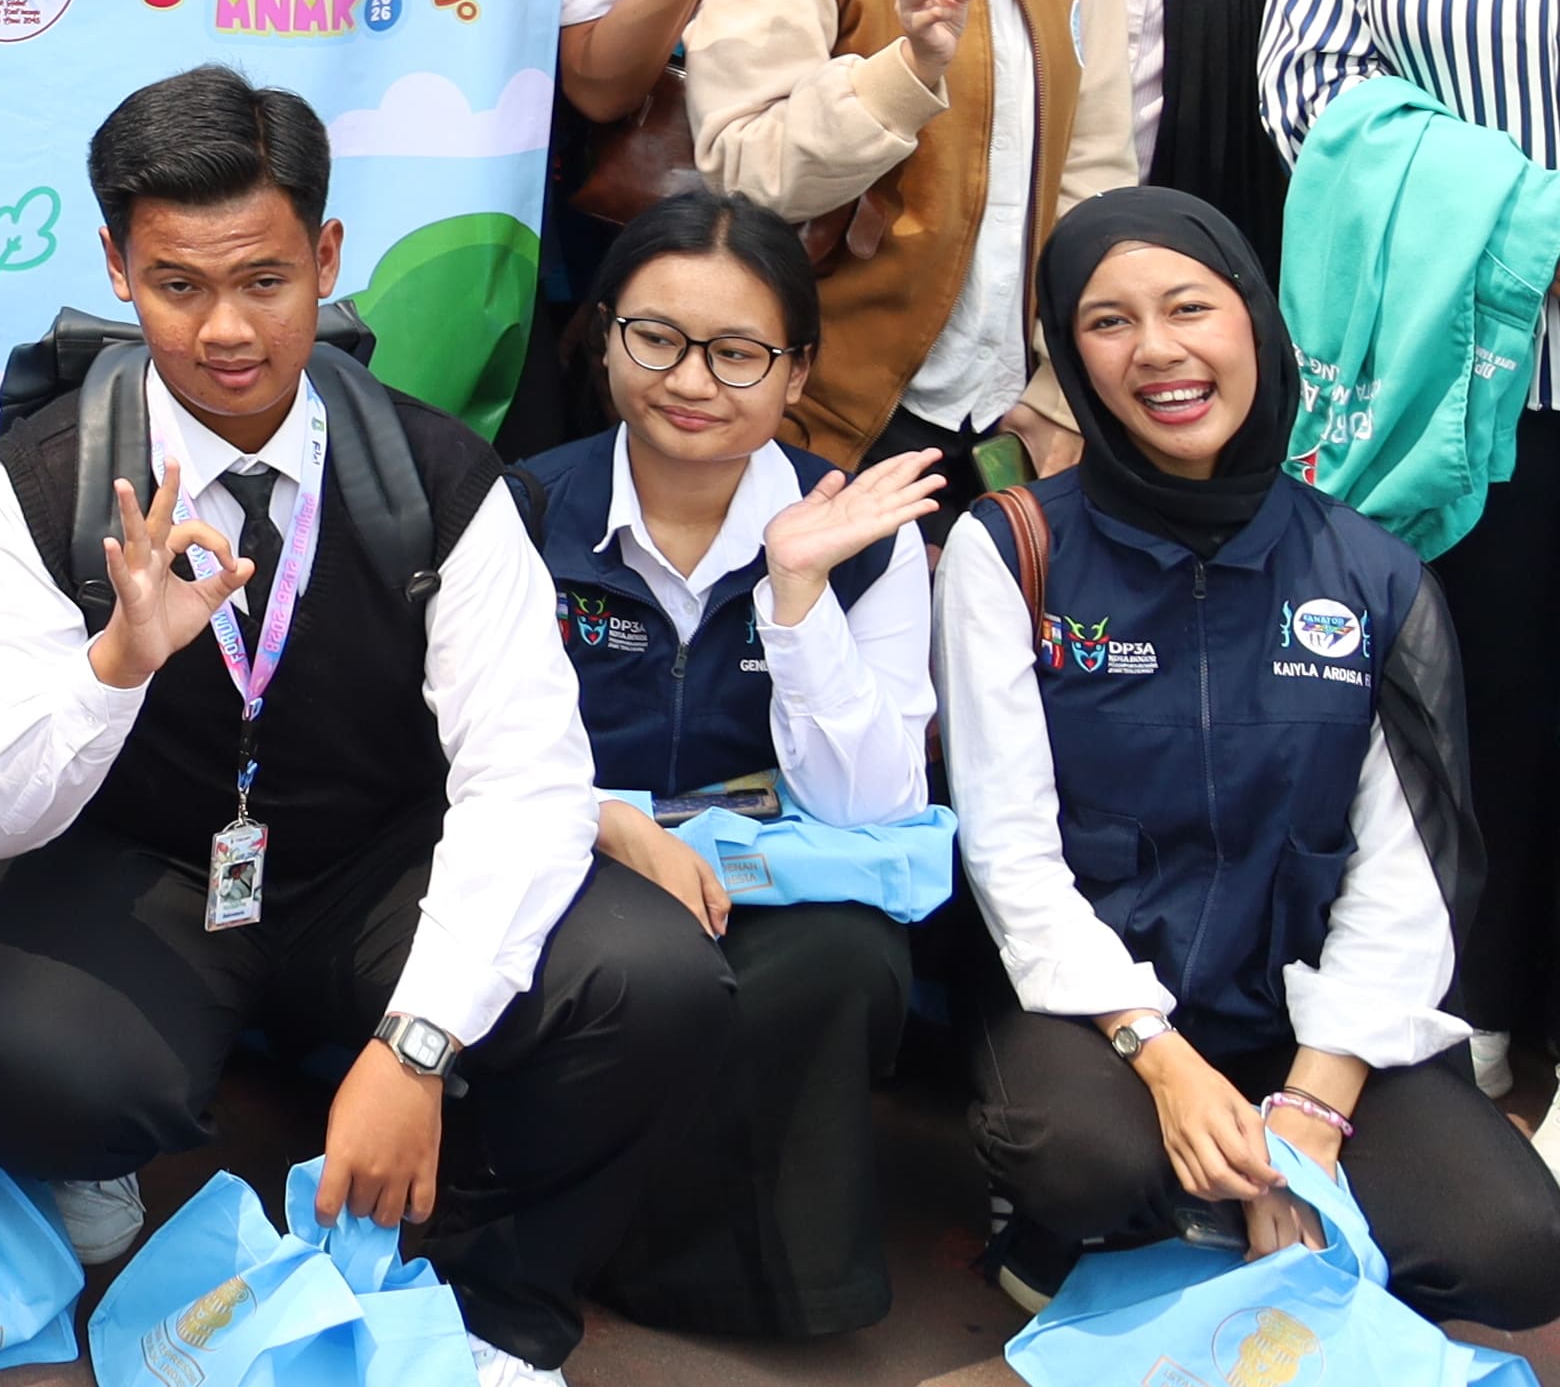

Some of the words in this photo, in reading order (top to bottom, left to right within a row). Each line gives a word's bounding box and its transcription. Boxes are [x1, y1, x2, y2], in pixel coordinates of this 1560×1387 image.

[370, 6, 392, 22] 26
[1107, 640, 1157, 656] DP3A
[1273, 660, 1319, 678] KAIYLA
[1323, 665, 1364, 687] ARDISA
